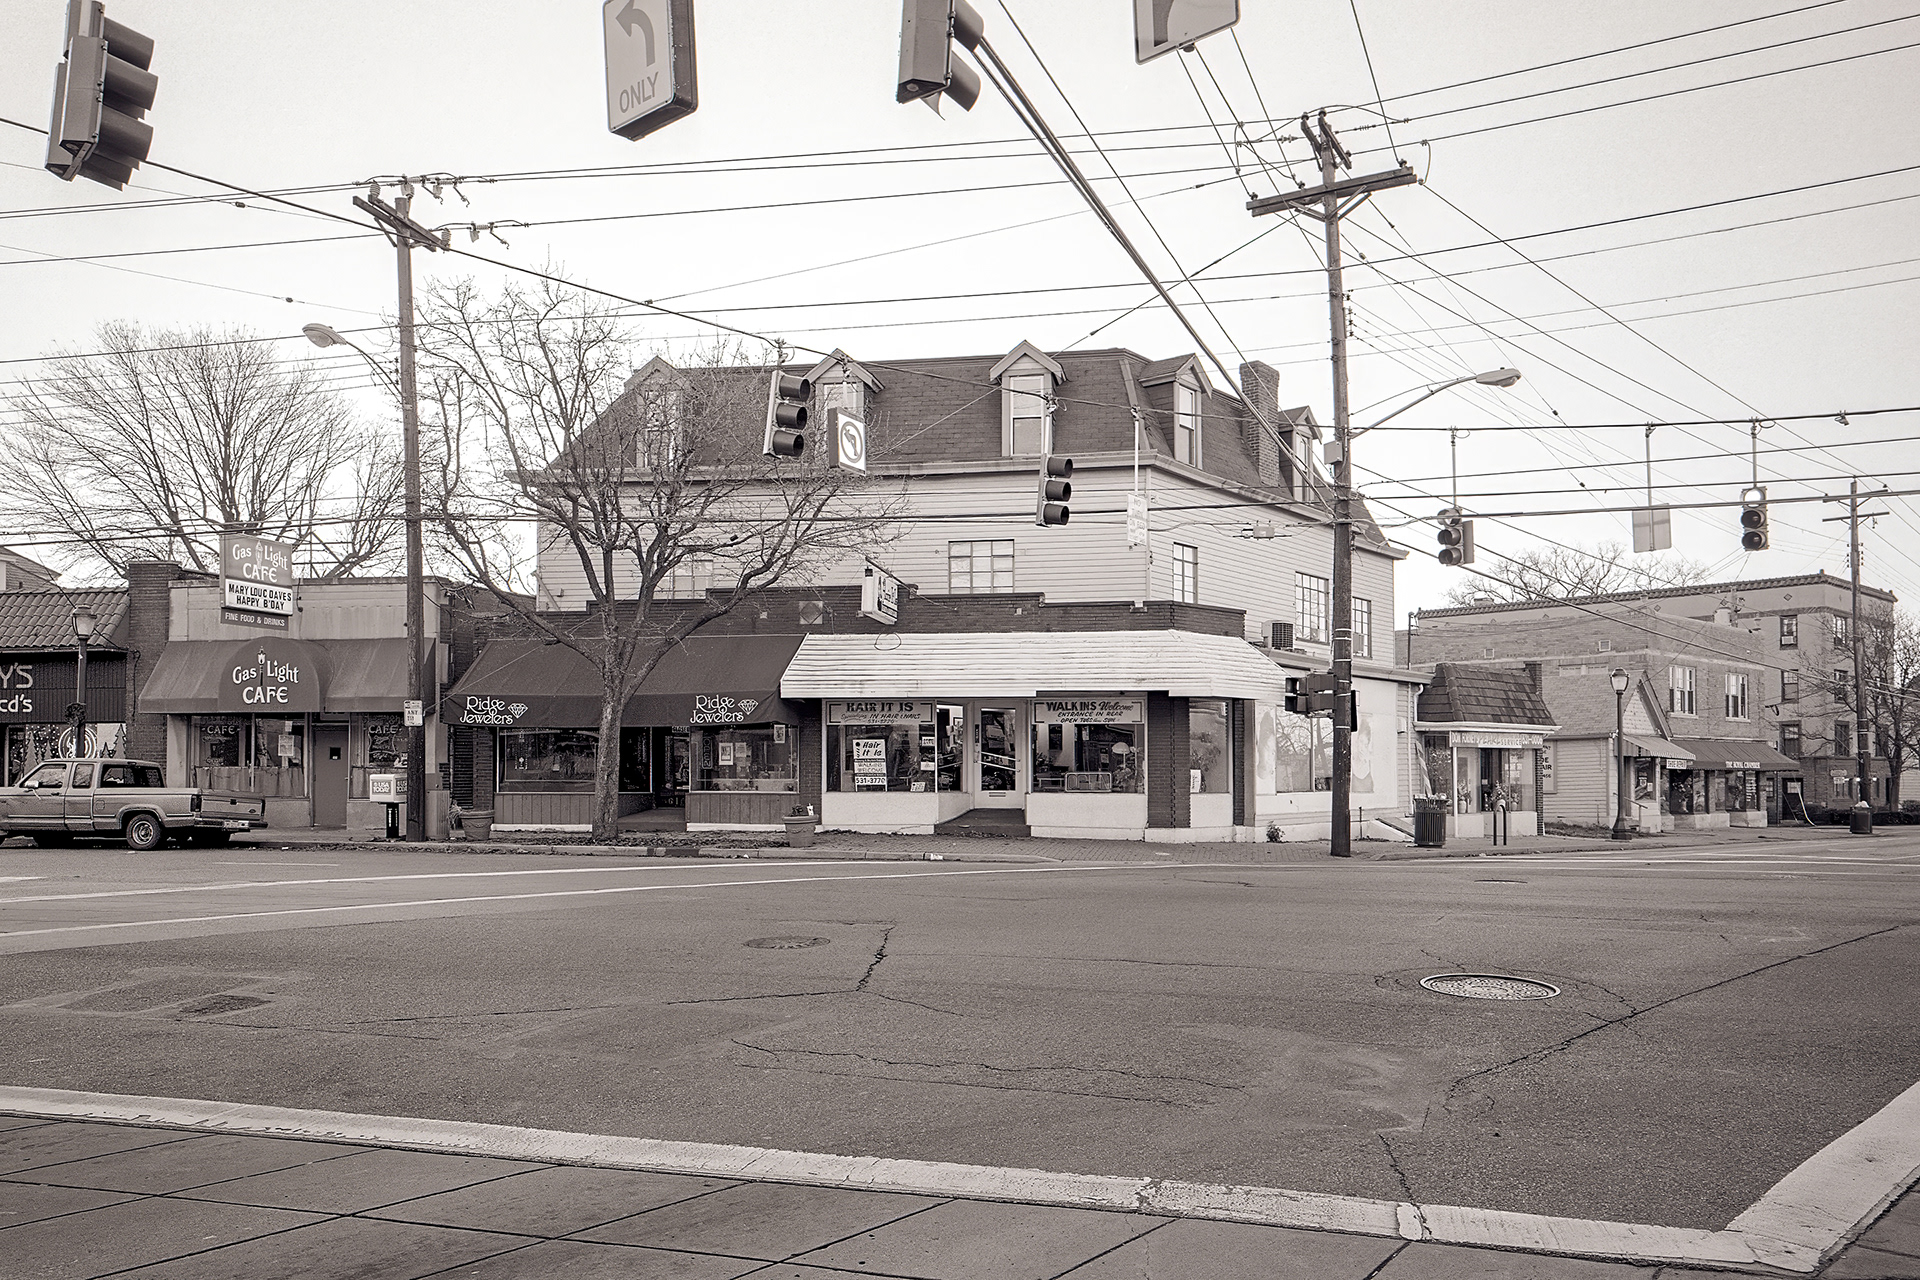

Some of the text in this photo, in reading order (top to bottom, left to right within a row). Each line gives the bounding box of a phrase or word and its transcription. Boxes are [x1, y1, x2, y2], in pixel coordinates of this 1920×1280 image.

[620, 71, 659, 114] ONLY
[232, 544, 288, 570] Gas Light
[242, 562, 278, 582] CAFE
[228, 584, 248, 595] MARY
[268, 590, 292, 602] DAVES
[236, 596, 284, 610] HAPPY B'DAY
[225, 612, 238, 620] FINE
[240, 614, 254, 622] FOOD
[264, 617, 285, 626] DRINKS
[232, 660, 300, 684] Gas Light
[242, 686, 288, 704] CAFE
[466, 696, 506, 716] Ridge
[696, 694, 735, 714] Ridge
[846, 702, 914, 712] HAIR IT IS
[1046, 700, 1134, 711] WALK INS Welcome
[460, 710, 514, 724] Jewelers
[690, 710, 744, 724] Jewelers
[207, 726, 236, 734] CAFE
[369, 724, 398, 734] CAFE
